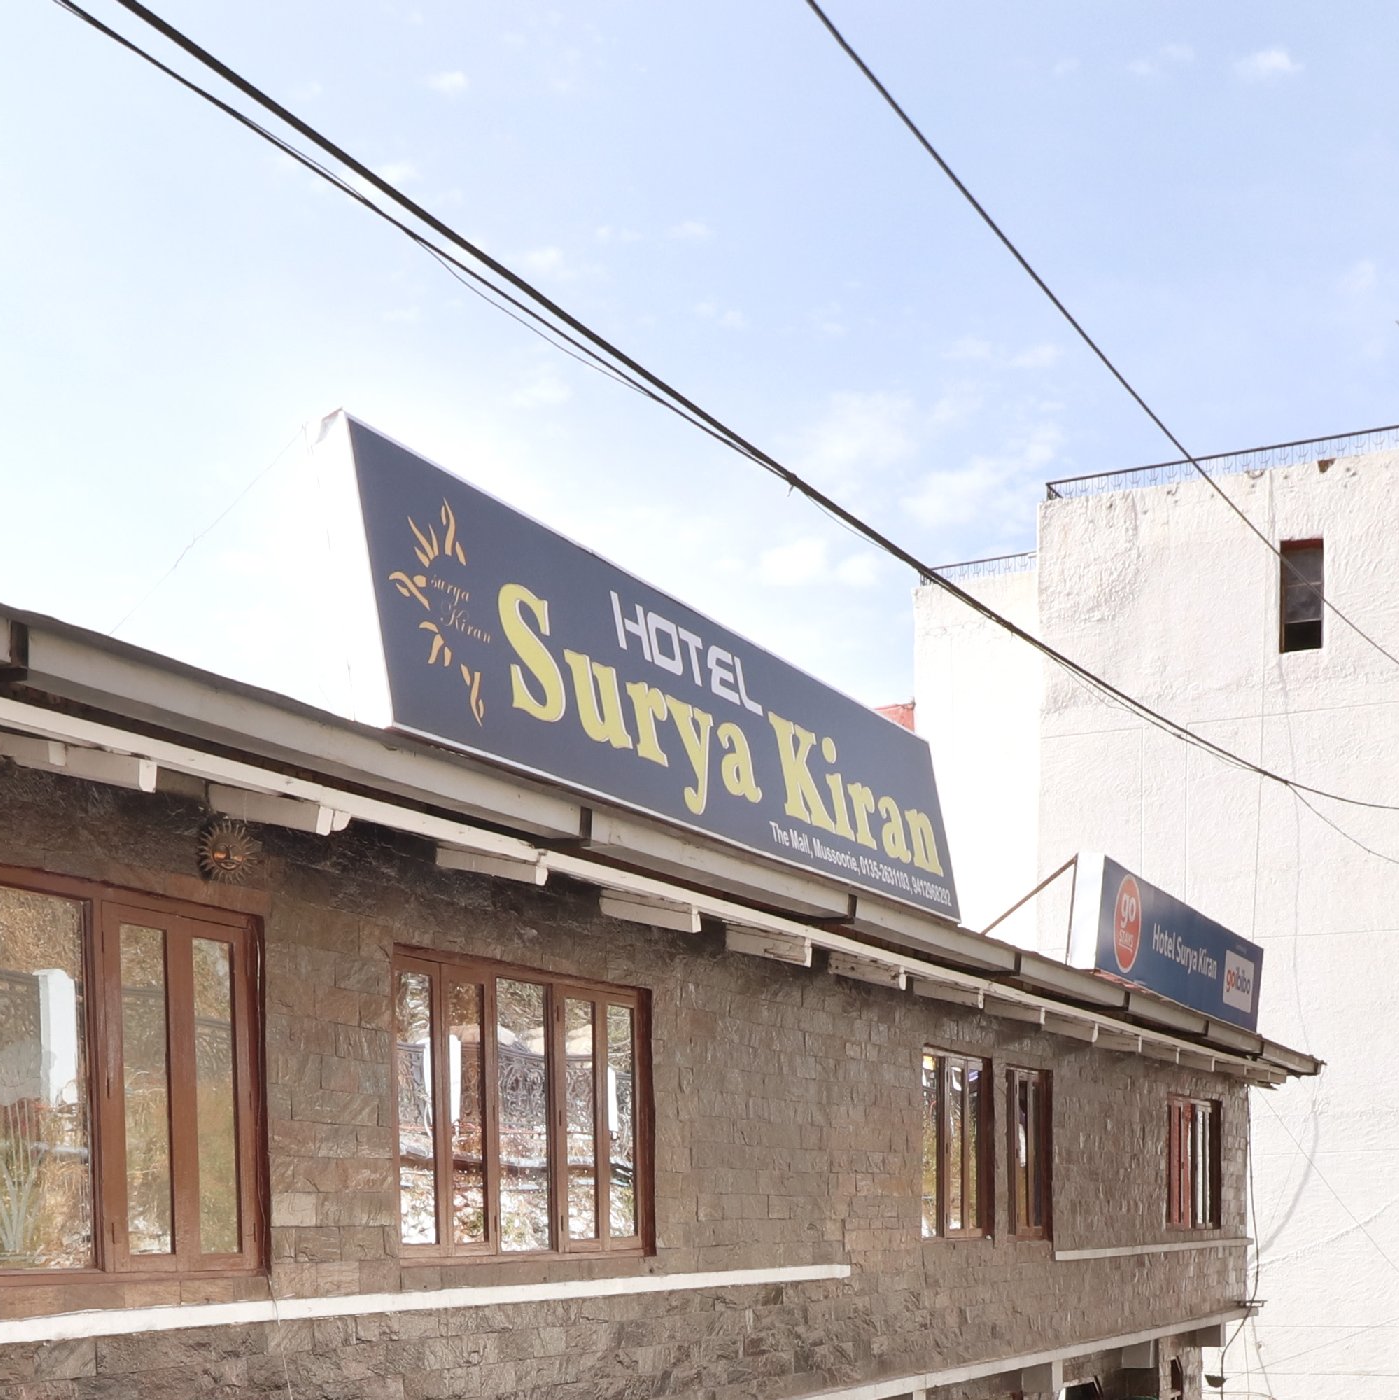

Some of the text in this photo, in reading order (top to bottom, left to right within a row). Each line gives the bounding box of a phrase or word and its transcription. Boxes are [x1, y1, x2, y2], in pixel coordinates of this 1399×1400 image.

[440, 599, 491, 644] Kiran
[609, 590, 763, 716] HOTEL
[498, 583, 943, 877] Surya Kiran
[769, 821, 789, 847] The
[1120, 893, 1136, 928] go
[1152, 922, 1218, 979] Hotel Surya Kiran
